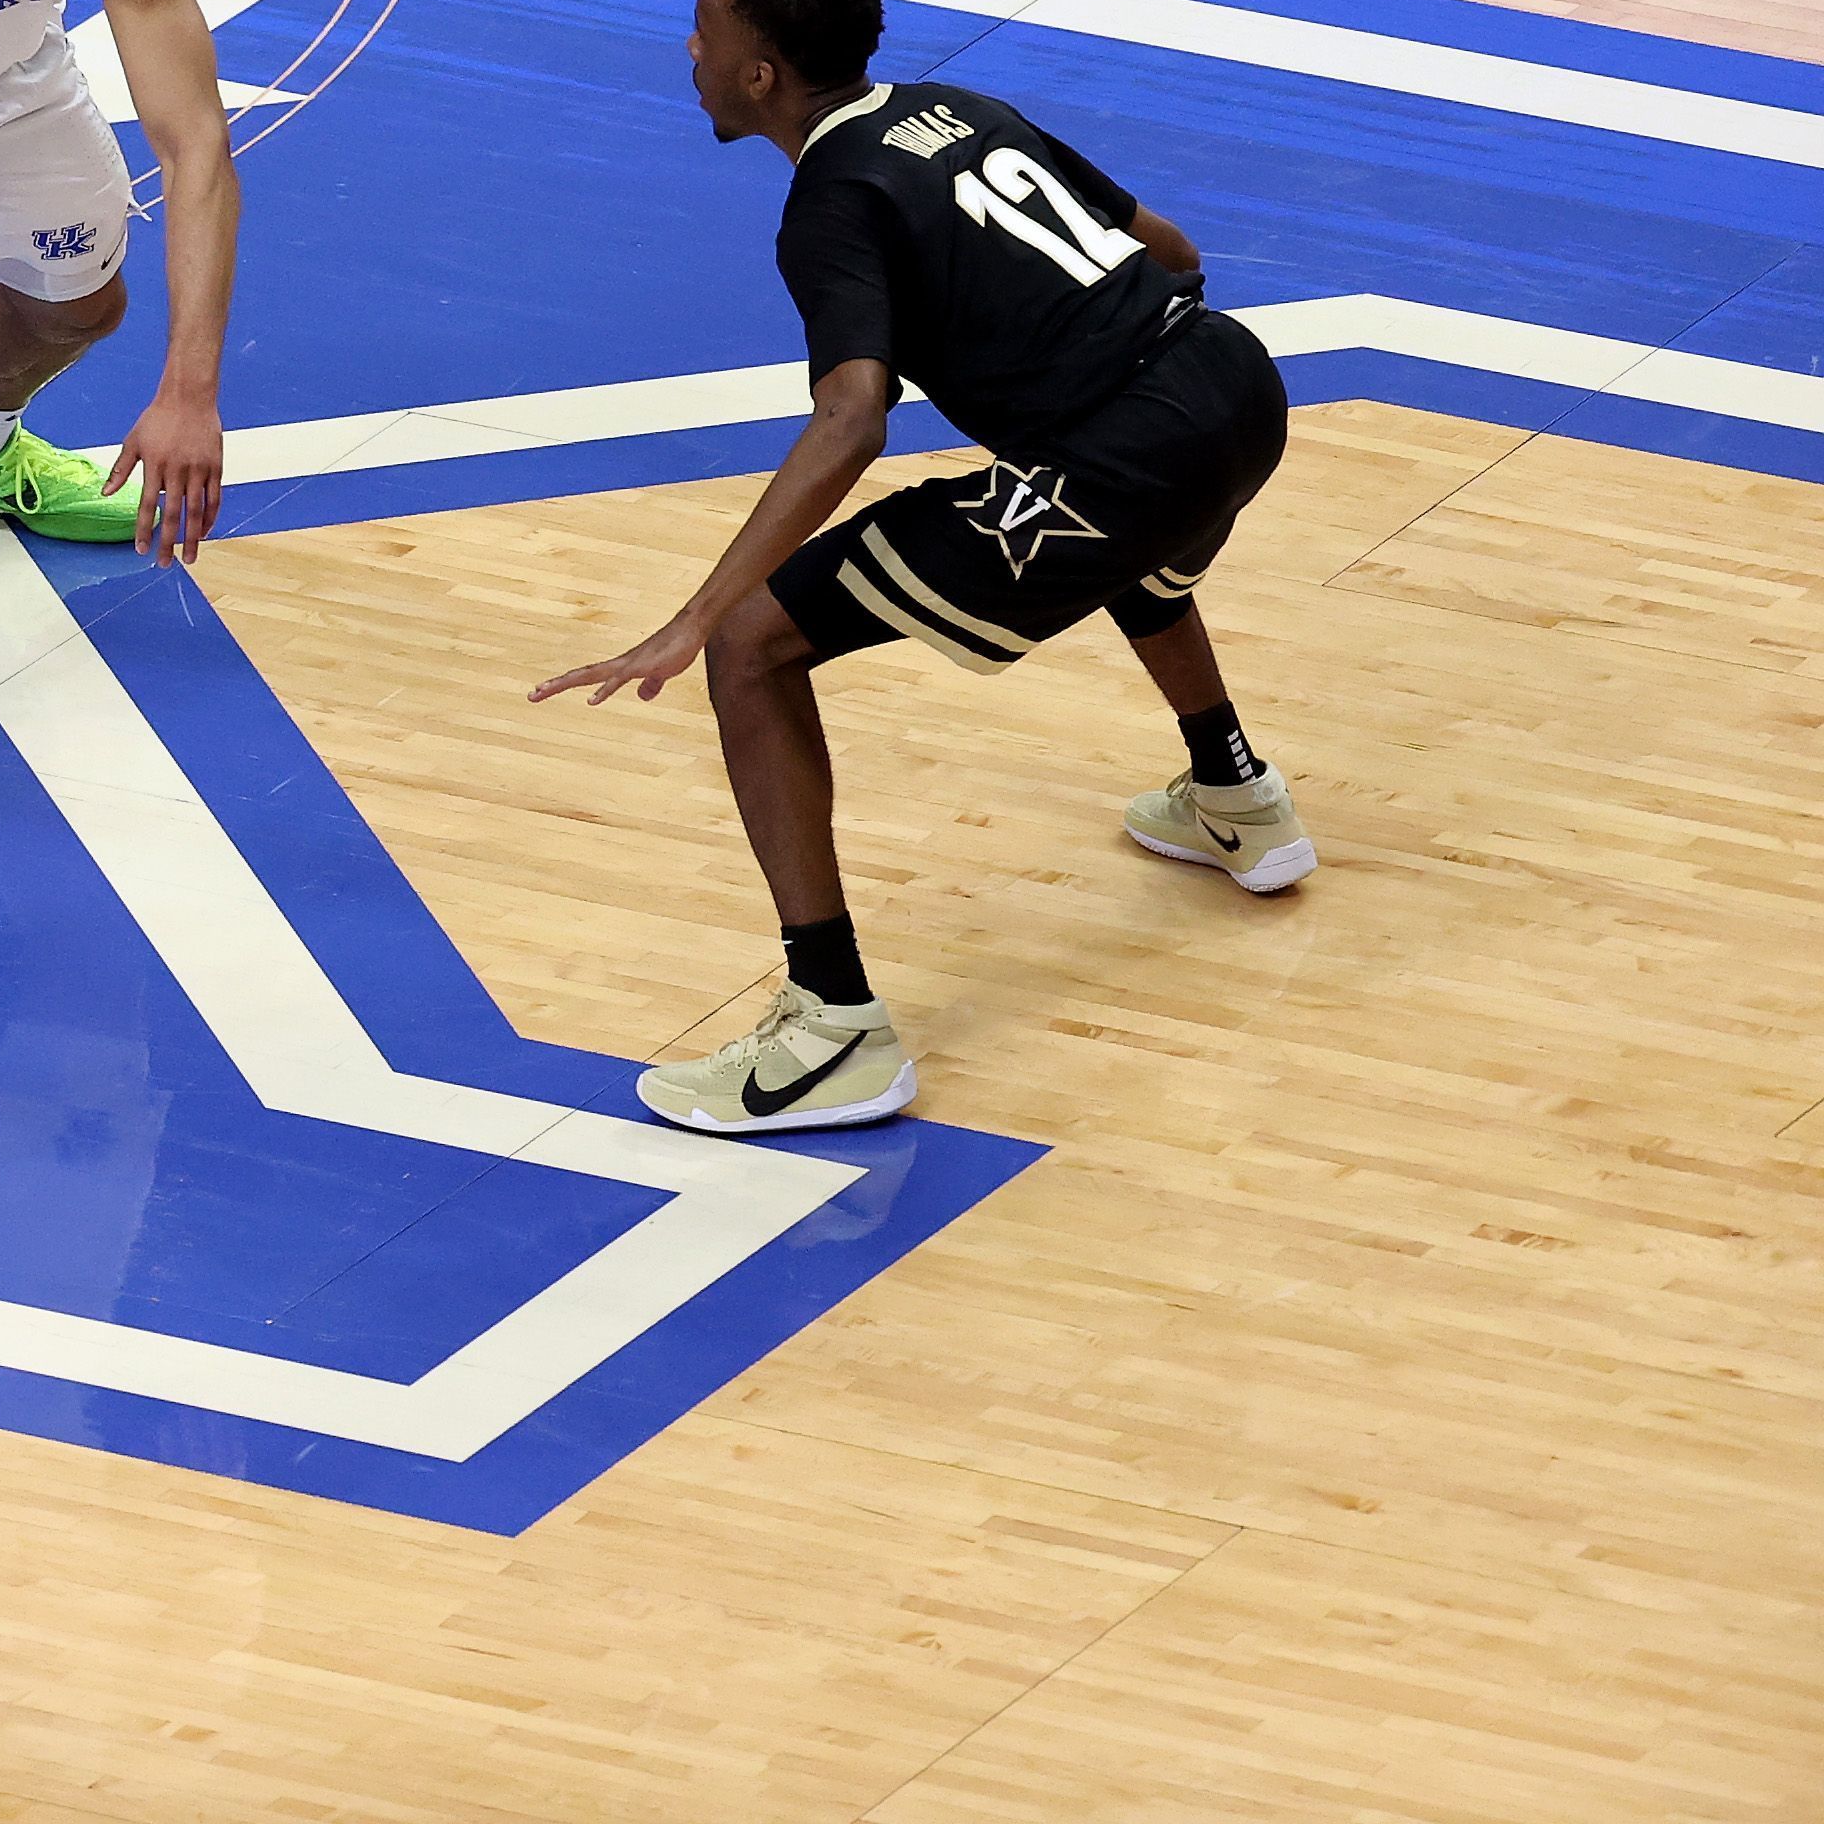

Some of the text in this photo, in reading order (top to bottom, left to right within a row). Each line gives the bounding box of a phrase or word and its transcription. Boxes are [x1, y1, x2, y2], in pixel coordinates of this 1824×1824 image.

[882, 104, 975, 160] THOMAS
[31, 221, 97, 261] UK
[953, 147, 1148, 288] 12
[998, 481, 1052, 532] V
